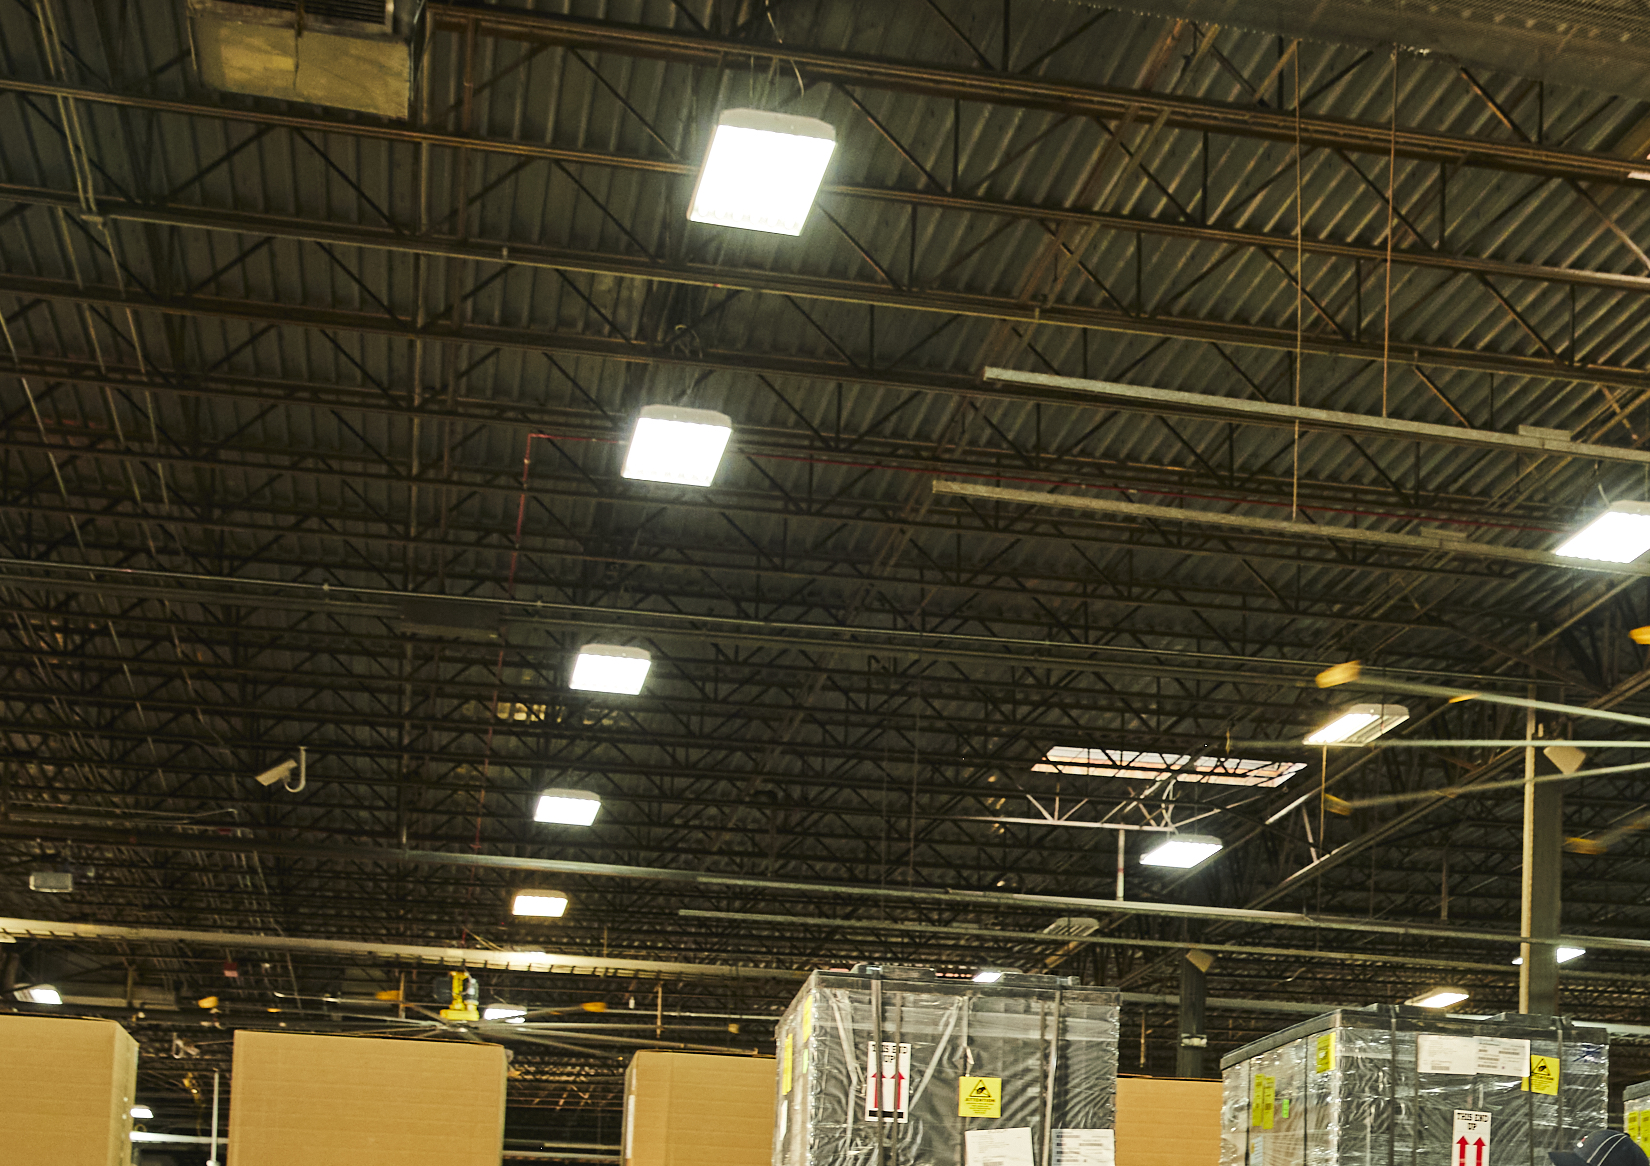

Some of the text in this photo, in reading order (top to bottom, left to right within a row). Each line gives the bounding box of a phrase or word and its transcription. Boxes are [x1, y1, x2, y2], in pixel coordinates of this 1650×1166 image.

[884, 1055, 895, 1063] UP
[1456, 1112, 1489, 1123] THIS END
[1467, 1122, 1478, 1131] UP
